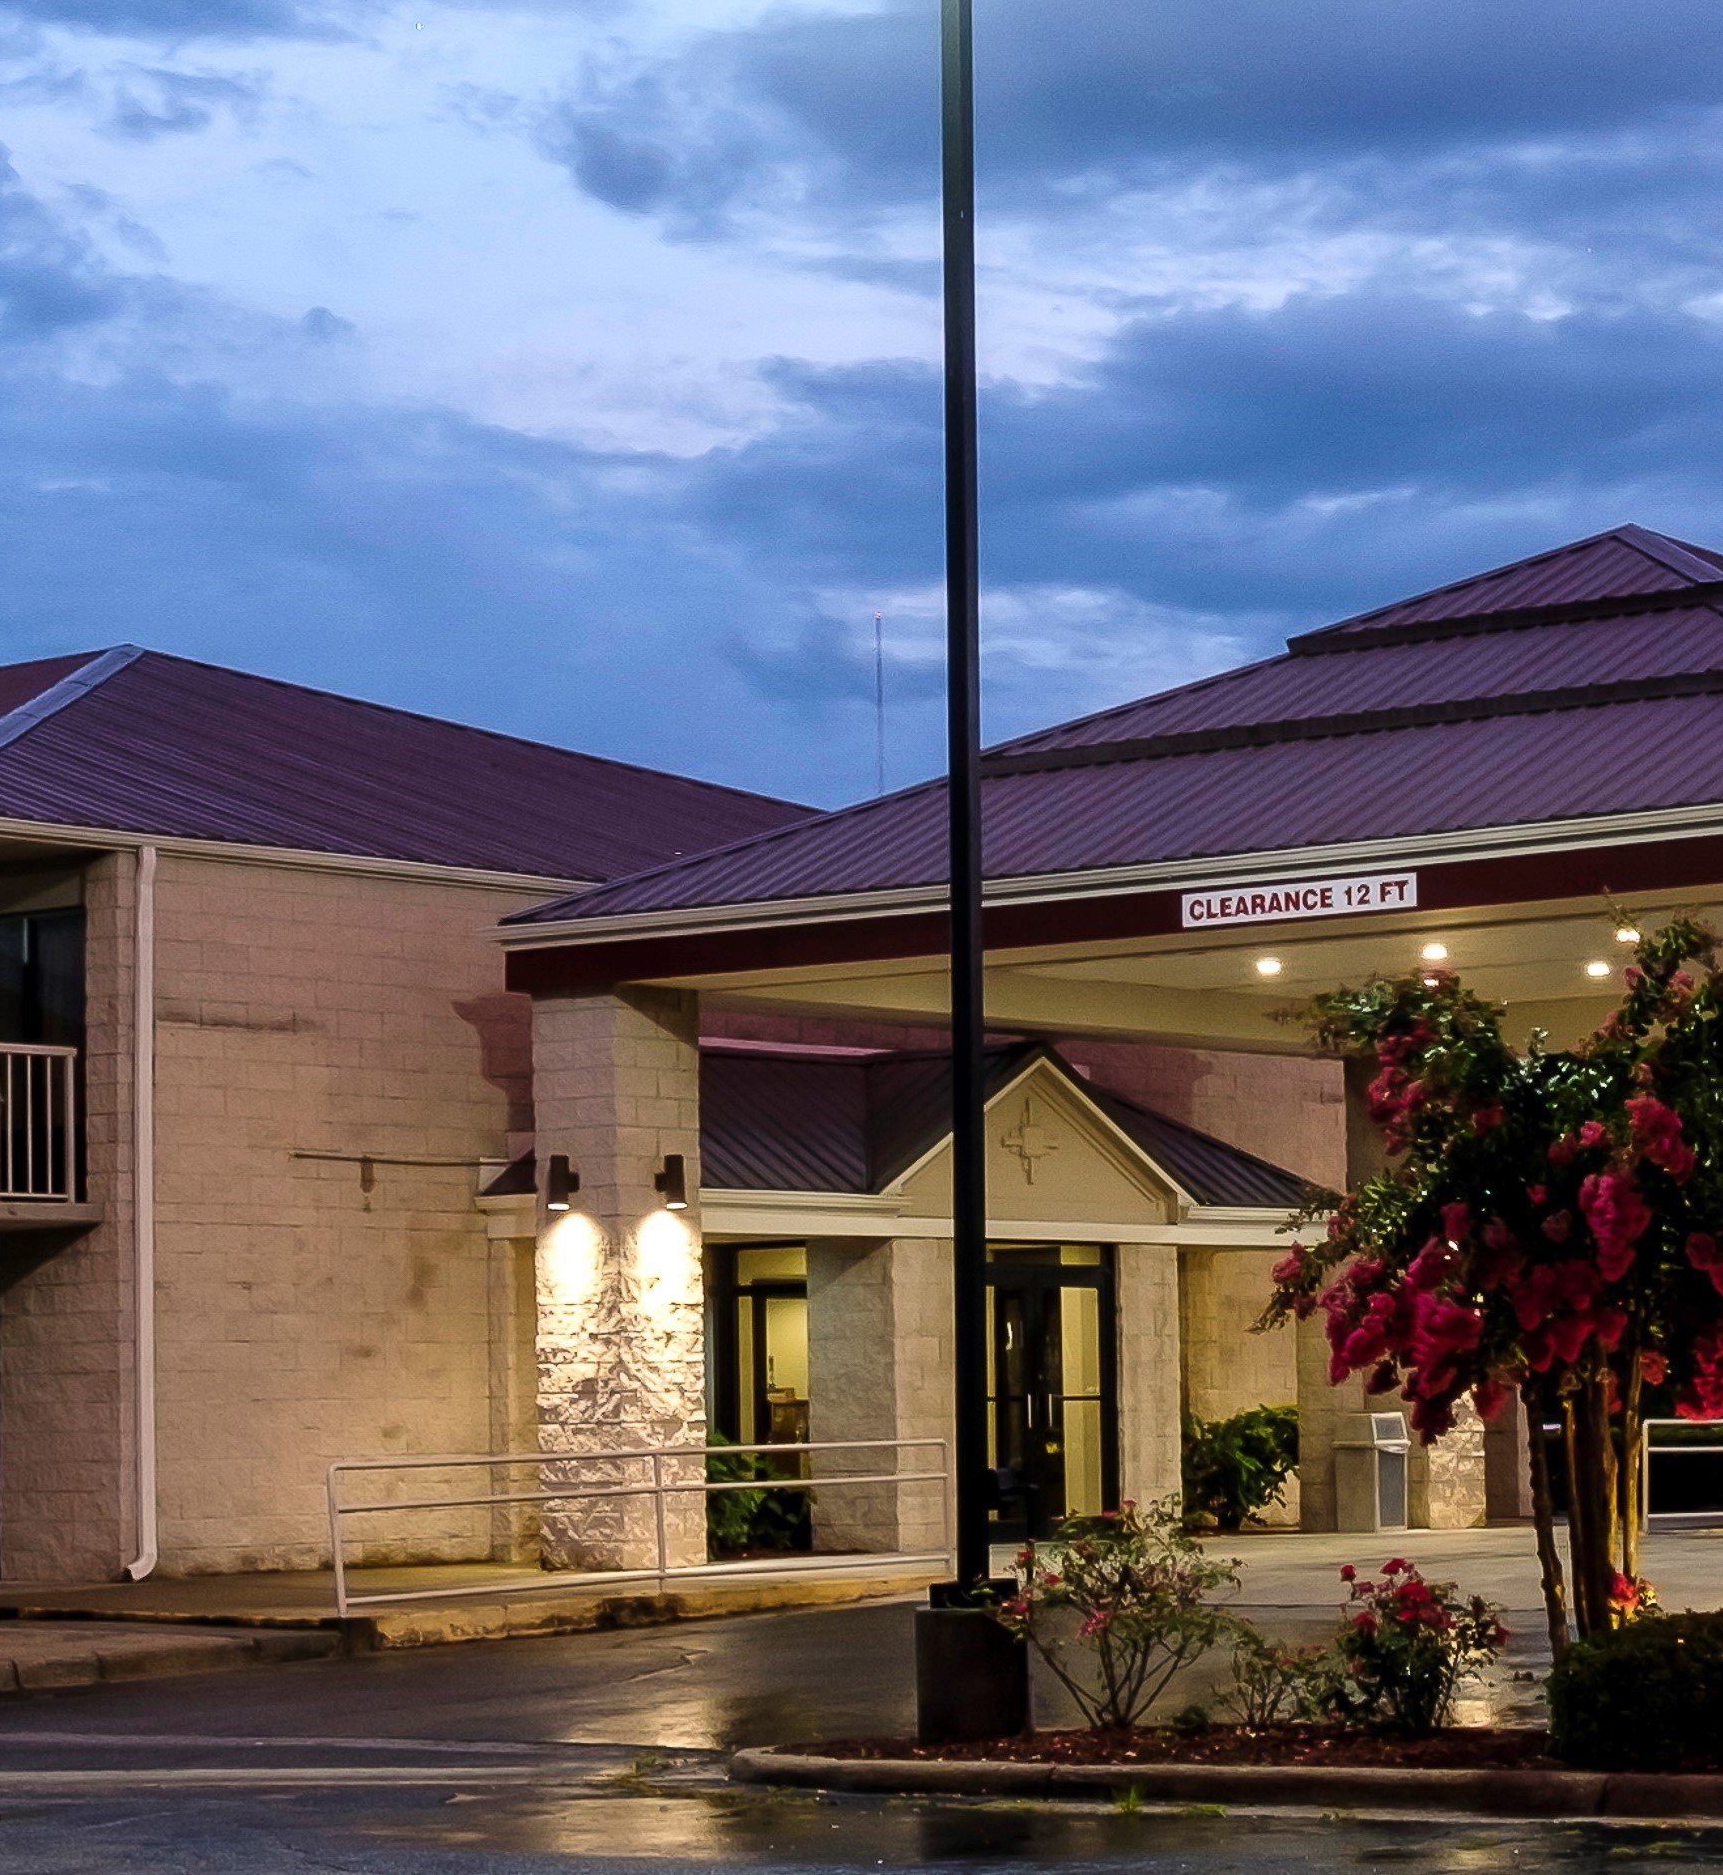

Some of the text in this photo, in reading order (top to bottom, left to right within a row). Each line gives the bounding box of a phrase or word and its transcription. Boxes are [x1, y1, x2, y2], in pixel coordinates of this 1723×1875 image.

[1188, 879, 1410, 921] CLEARANCE 12 FT
